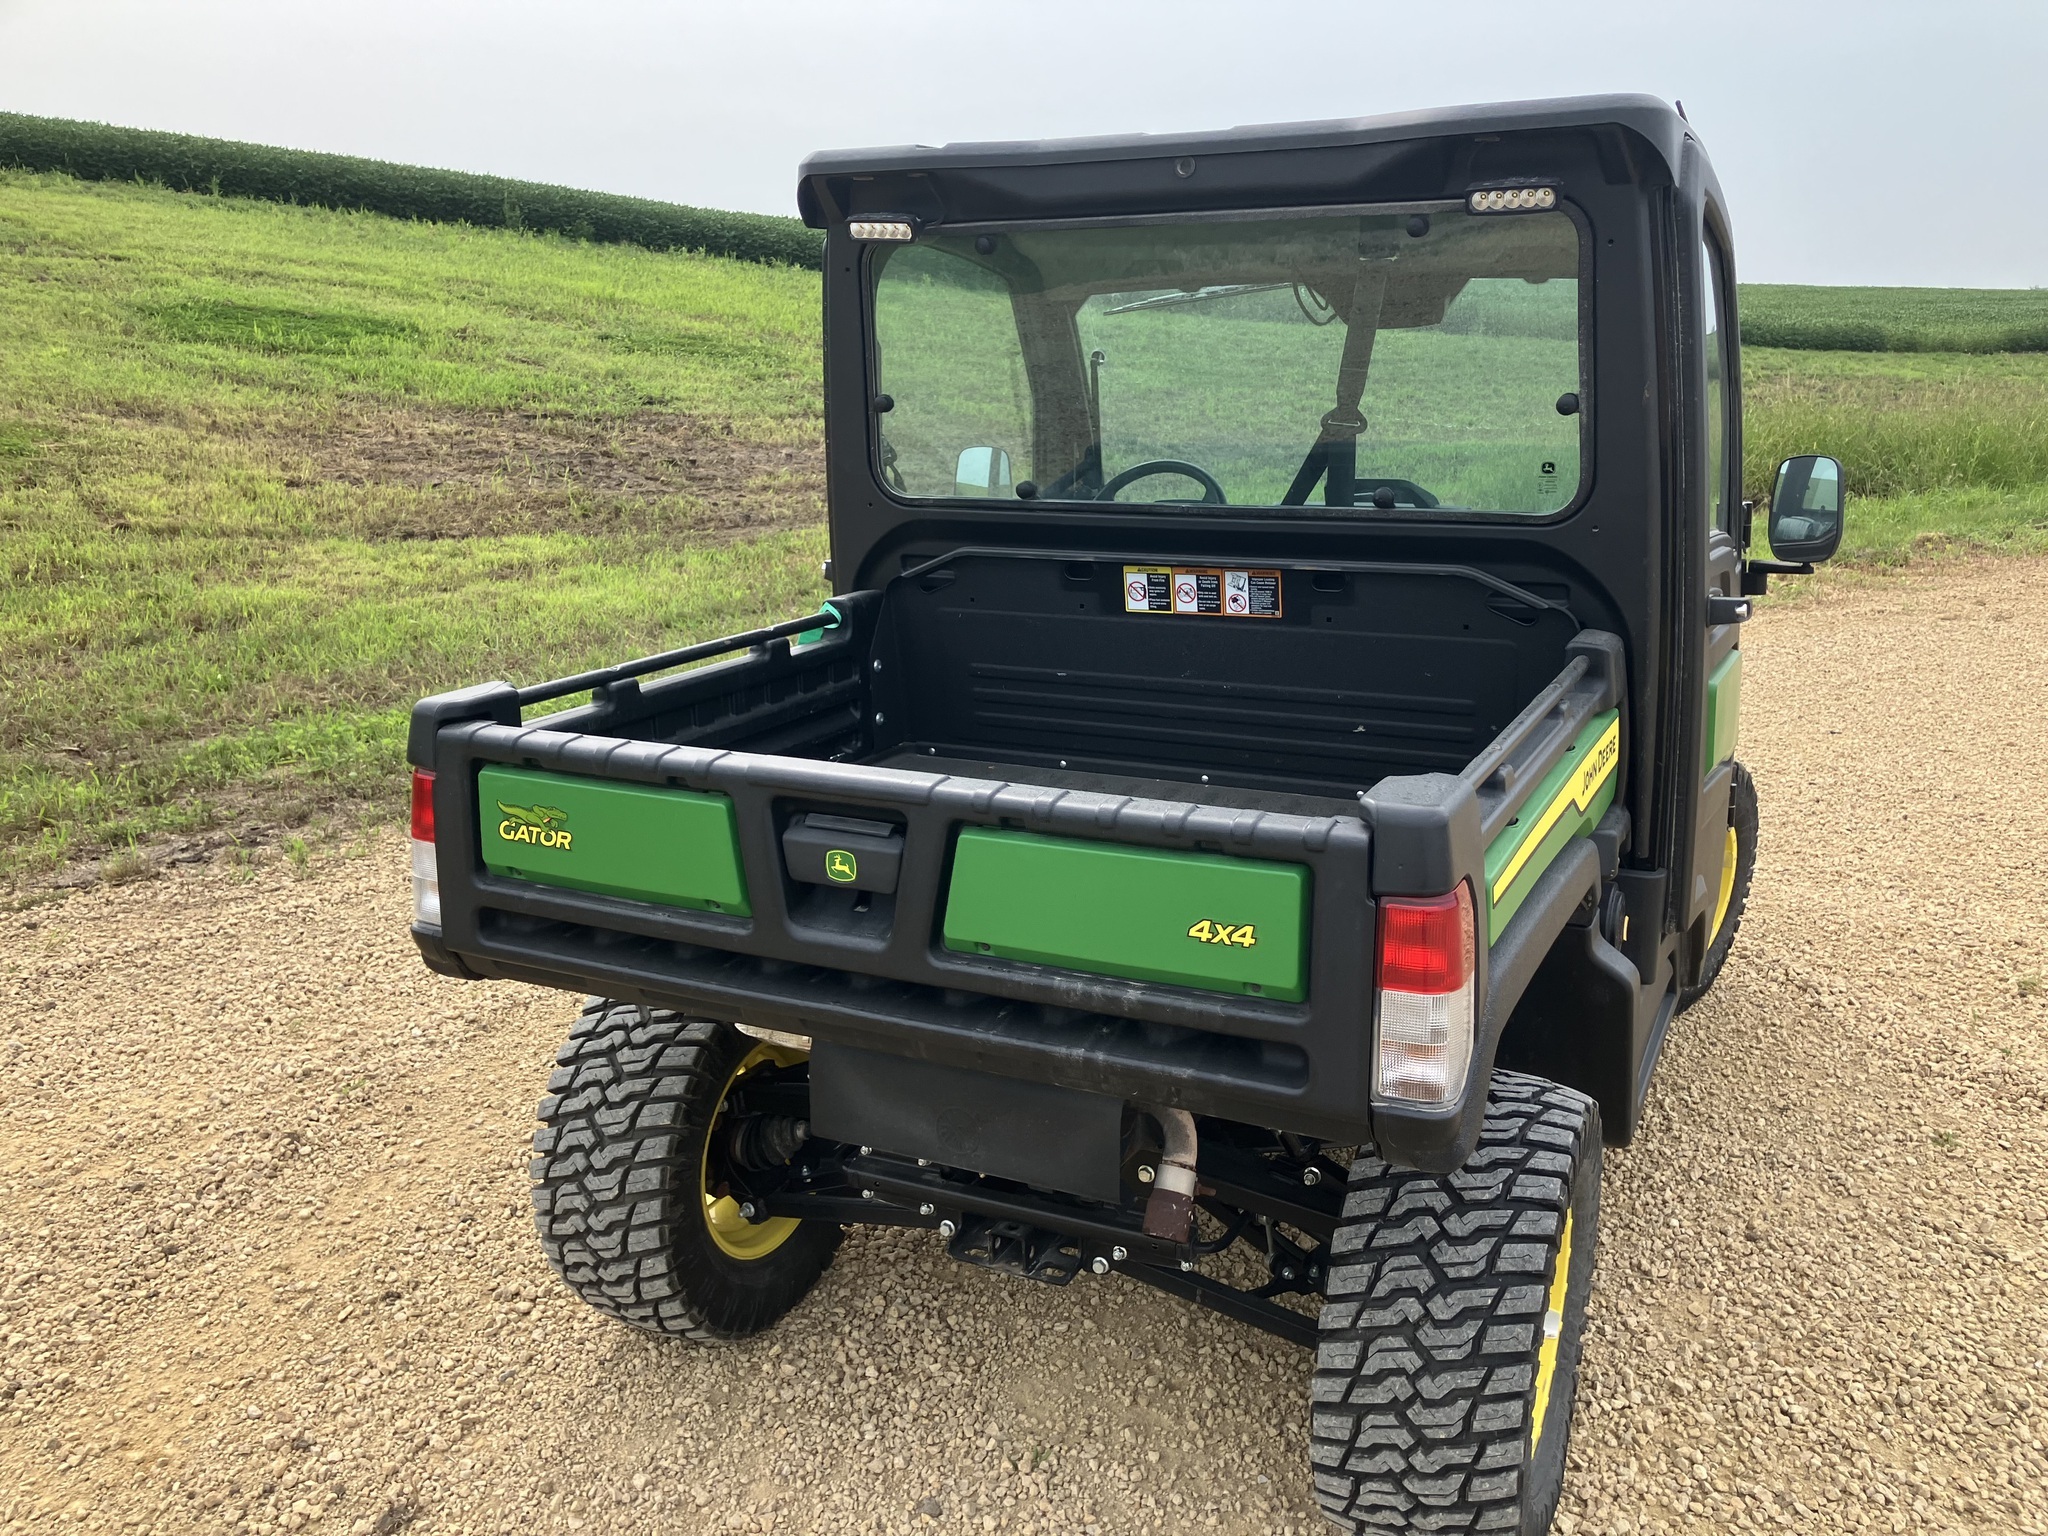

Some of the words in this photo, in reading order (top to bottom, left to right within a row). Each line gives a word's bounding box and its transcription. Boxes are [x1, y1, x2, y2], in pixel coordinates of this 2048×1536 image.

[1582, 759, 1598, 796] JOHN
[1598, 735, 1616, 773] DEERE
[498, 820, 573, 851] GATOR
